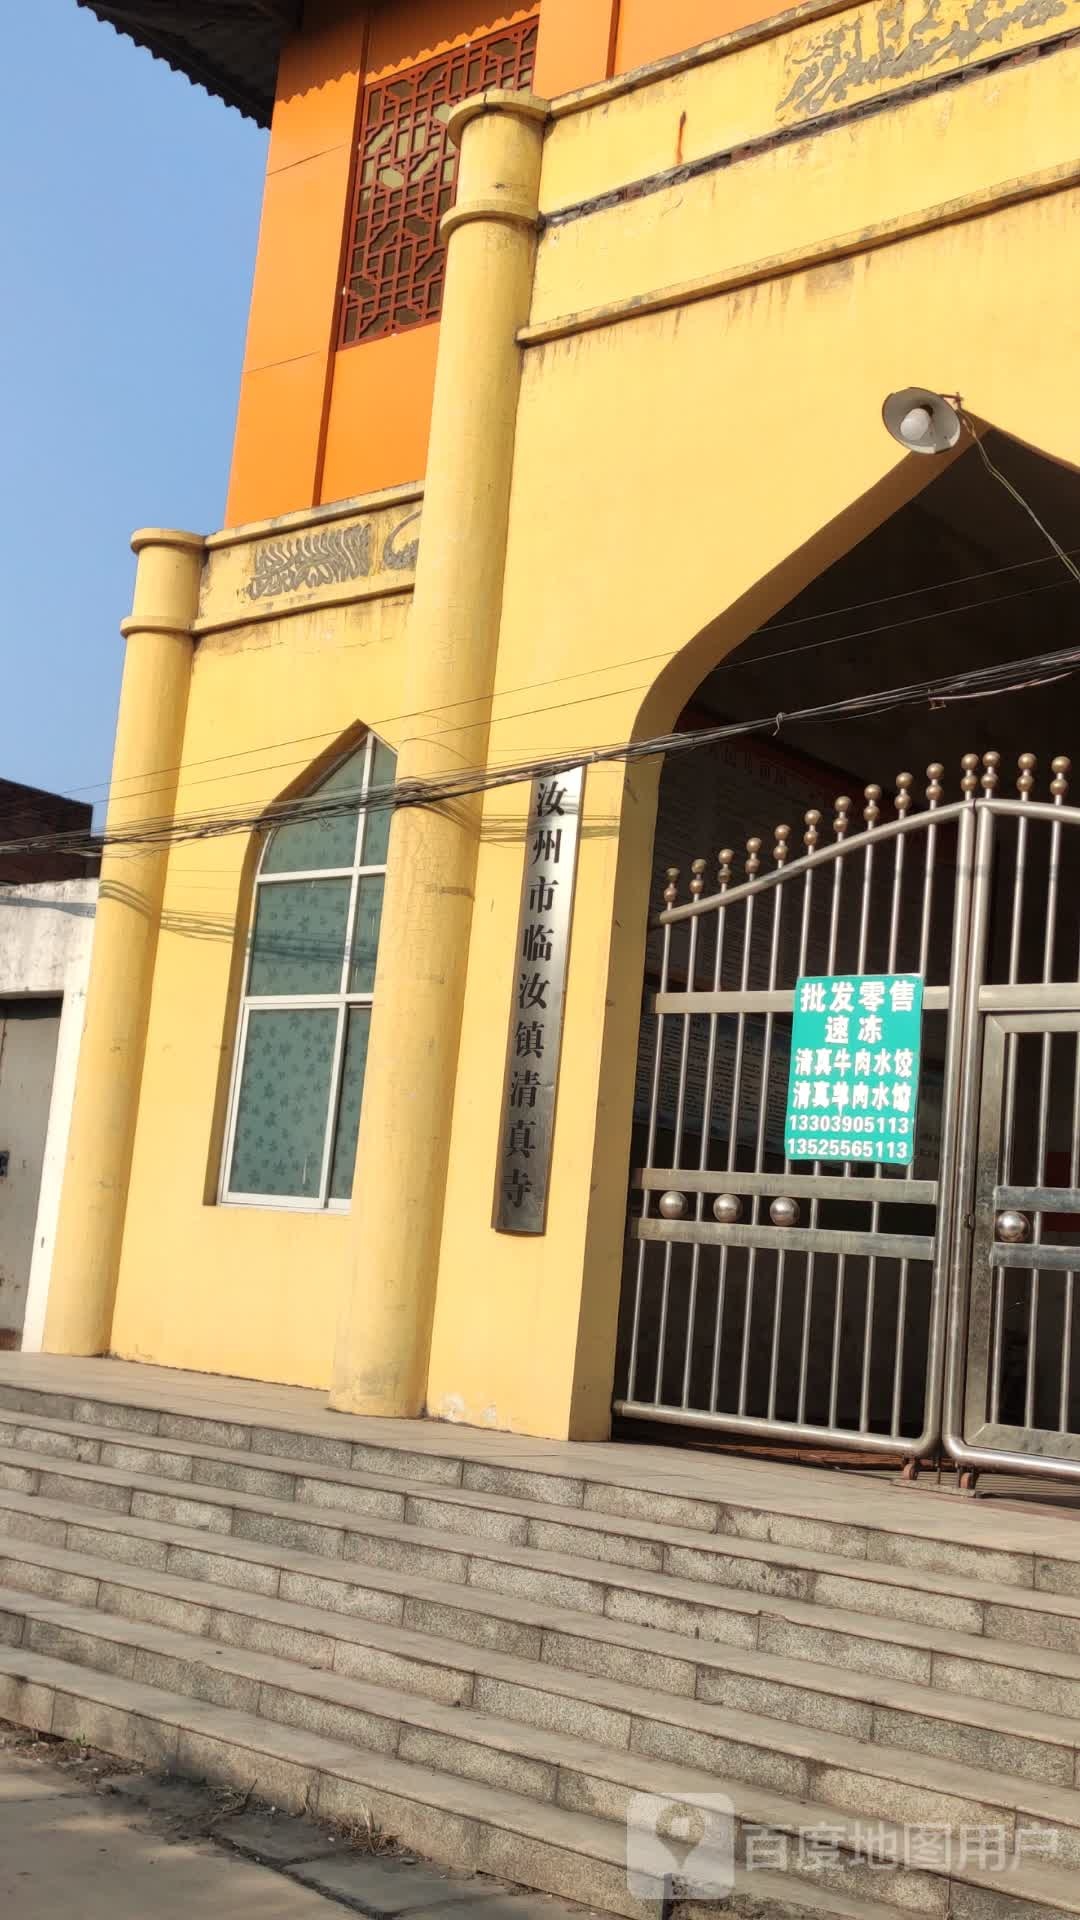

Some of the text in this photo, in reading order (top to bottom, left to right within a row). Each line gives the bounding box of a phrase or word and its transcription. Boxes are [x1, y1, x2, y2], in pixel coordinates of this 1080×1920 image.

[502, 780, 569, 1209] 汝州市临汝镇清真寺
[800, 980, 914, 1012] 批发零售
[824, 1014, 883, 1045] 速冻
[794, 1048, 913, 1077] 清真牛肉水饺
[789, 1114, 909, 1134] 13303905113
[787, 1138, 908, 1159] 13525565113
